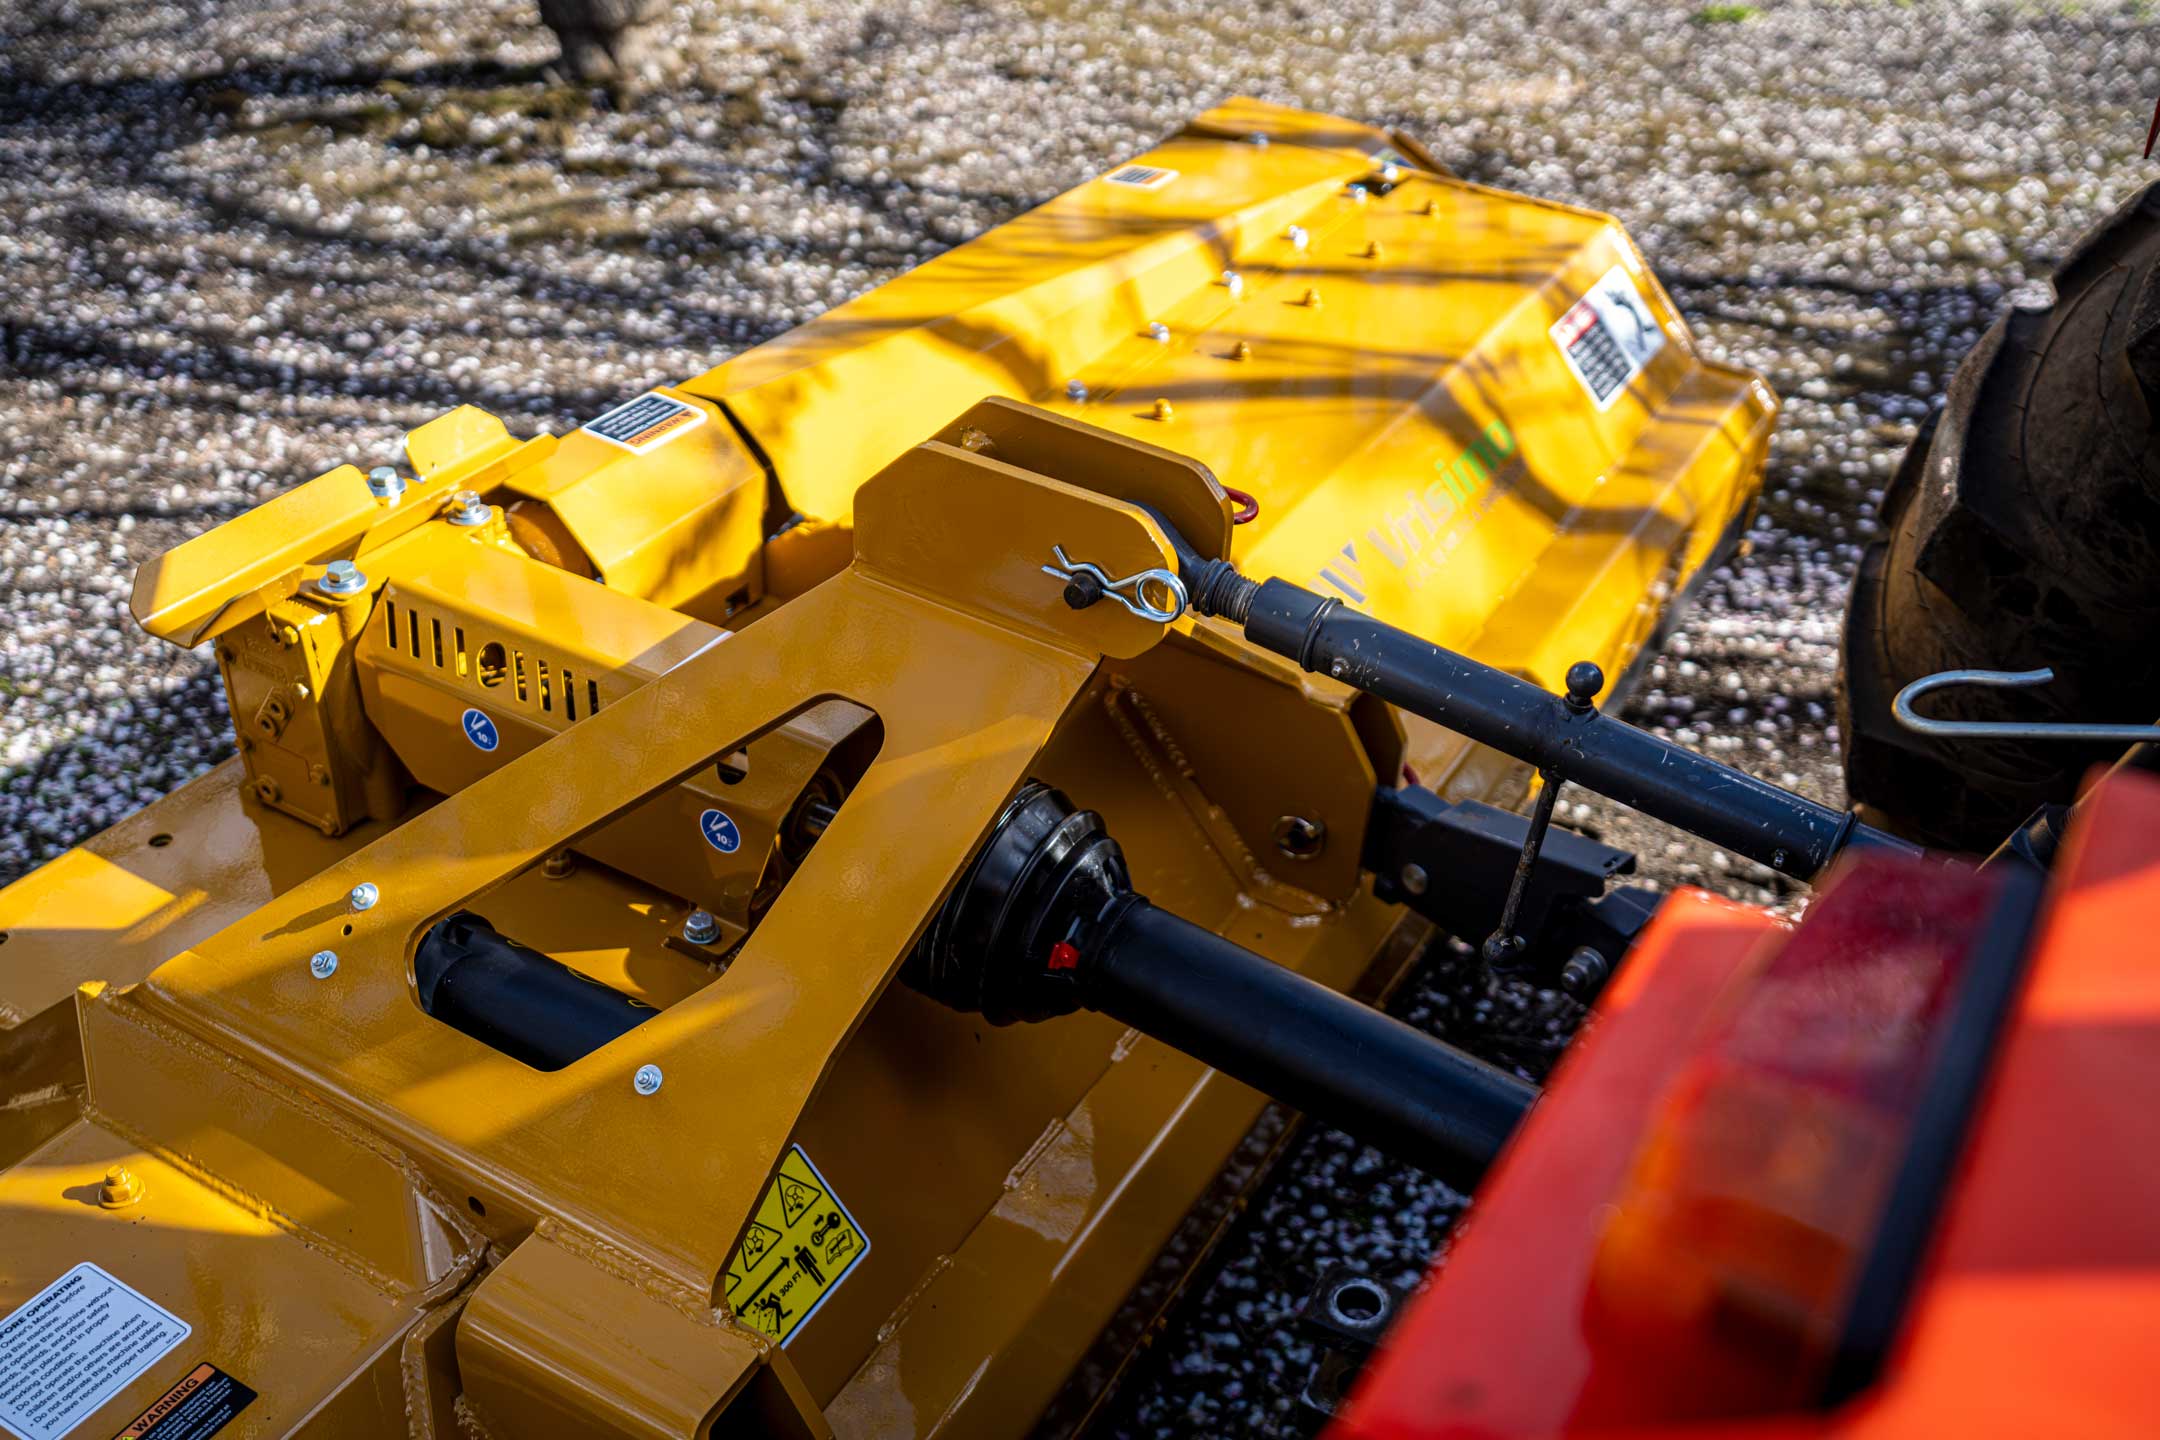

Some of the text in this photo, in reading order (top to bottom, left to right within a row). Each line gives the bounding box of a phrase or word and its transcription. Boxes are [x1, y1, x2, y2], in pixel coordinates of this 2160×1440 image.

[1368, 419, 1516, 570] Vrisimo
[477, 732, 488, 743] 10
[716, 833, 728, 845] 10
[0, 1285, 85, 1348] Owner's Manual before
[26, 1276, 82, 1317] OPERATING
[779, 1271, 801, 1297] 300 FT
[0, 1375, 30, 1399] devices
[39, 1352, 60, 1370] place
[62, 1338, 77, 1352] and
[84, 1313, 110, 1334] proper
[10, 1343, 40, 1366] operate
[40, 1332, 54, 1343] the
[54, 1308, 86, 1333] machine
[86, 1287, 114, 1308] without
[10, 1342, 27, 1353] this
[26, 1316, 59, 1342] machine.
[20, 1349, 51, 1370] shields,
[51, 1334, 66, 1348] and
[66, 1319, 86, 1336] other
[86, 1302, 110, 1320] safety
[8, 1352, 78, 1405] working condition.
[15, 1314, 141, 1411] Do not operate the machine when
[26, 1392, 58, 1417] children
[58, 1371, 83, 1392] and/or
[83, 1352, 108, 1372] others
[108, 1342, 121, 1353] are
[121, 1320, 148, 1342] around.
[33, 1412, 48, 1423] Do
[47, 1400, 62, 1413] not
[62, 1377, 92, 1401] operate
[91, 1366, 107, 1377] this
[107, 1340, 138, 1366] machine
[138, 1322, 163, 1341] unless
[42, 1416, 59, 1431] you
[58, 1400, 79, 1417] have
[79, 1373, 113, 1400] received
[112, 1353, 138, 1375] proper
[137, 1331, 167, 1354] training.
[132, 1378, 199, 1432] WARNING
